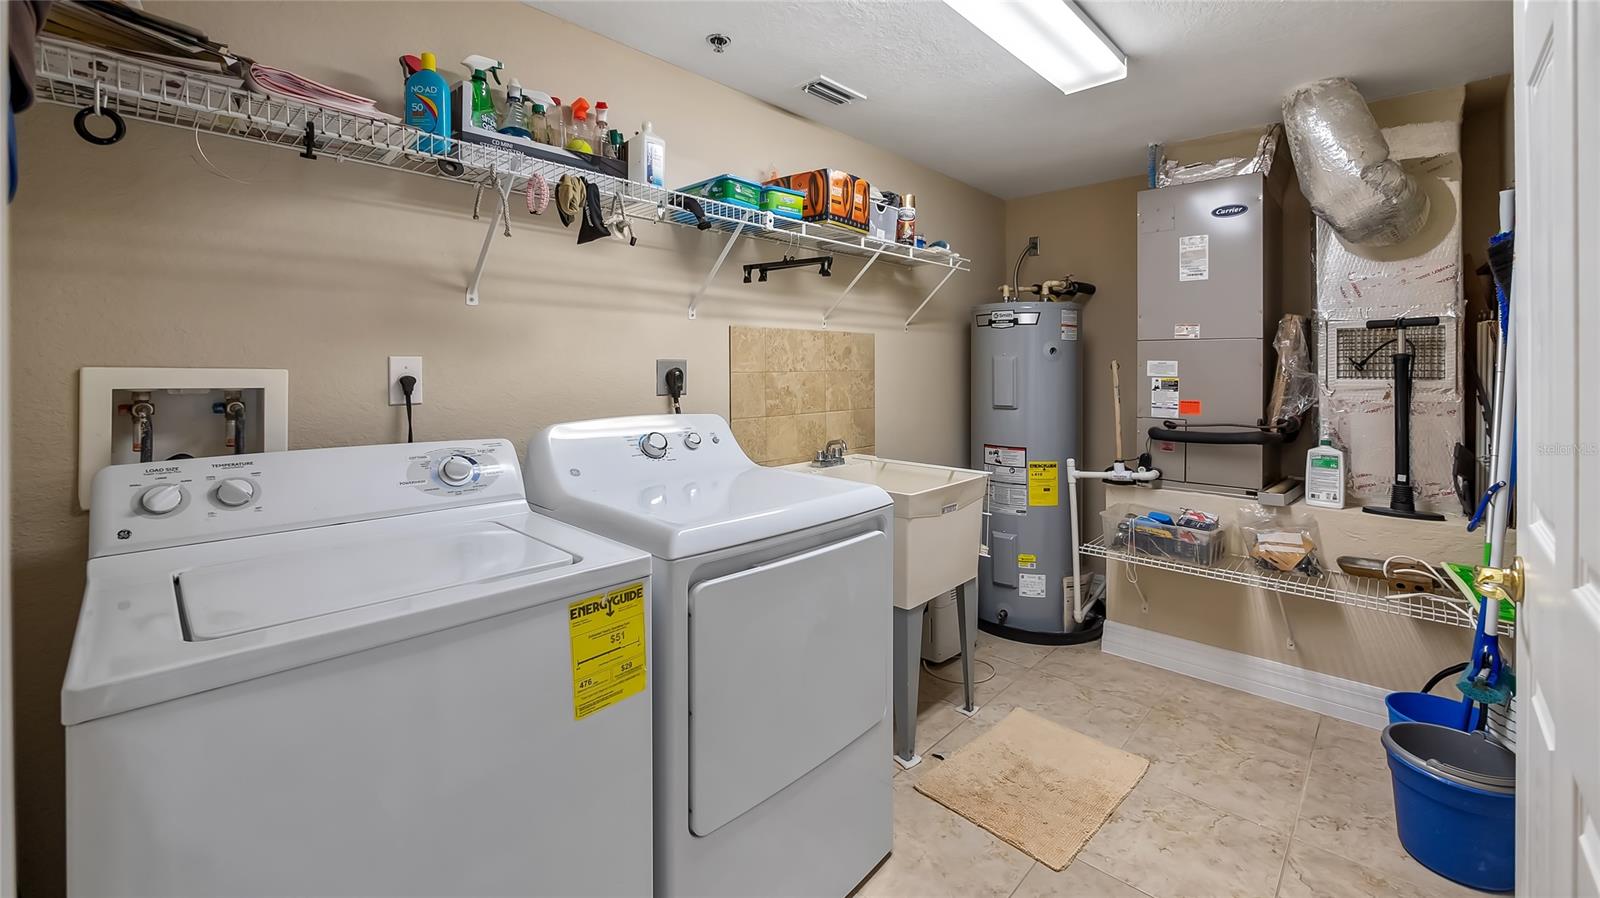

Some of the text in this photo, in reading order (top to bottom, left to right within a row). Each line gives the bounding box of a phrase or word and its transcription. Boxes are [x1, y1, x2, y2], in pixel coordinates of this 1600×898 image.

[411, 103, 424, 112] 50
[1215, 206, 1243, 216] Carrier
[570, 588, 643, 621] ENERGYGUIDE
[610, 630, 625, 643] $51
[579, 678, 593, 689] 476
